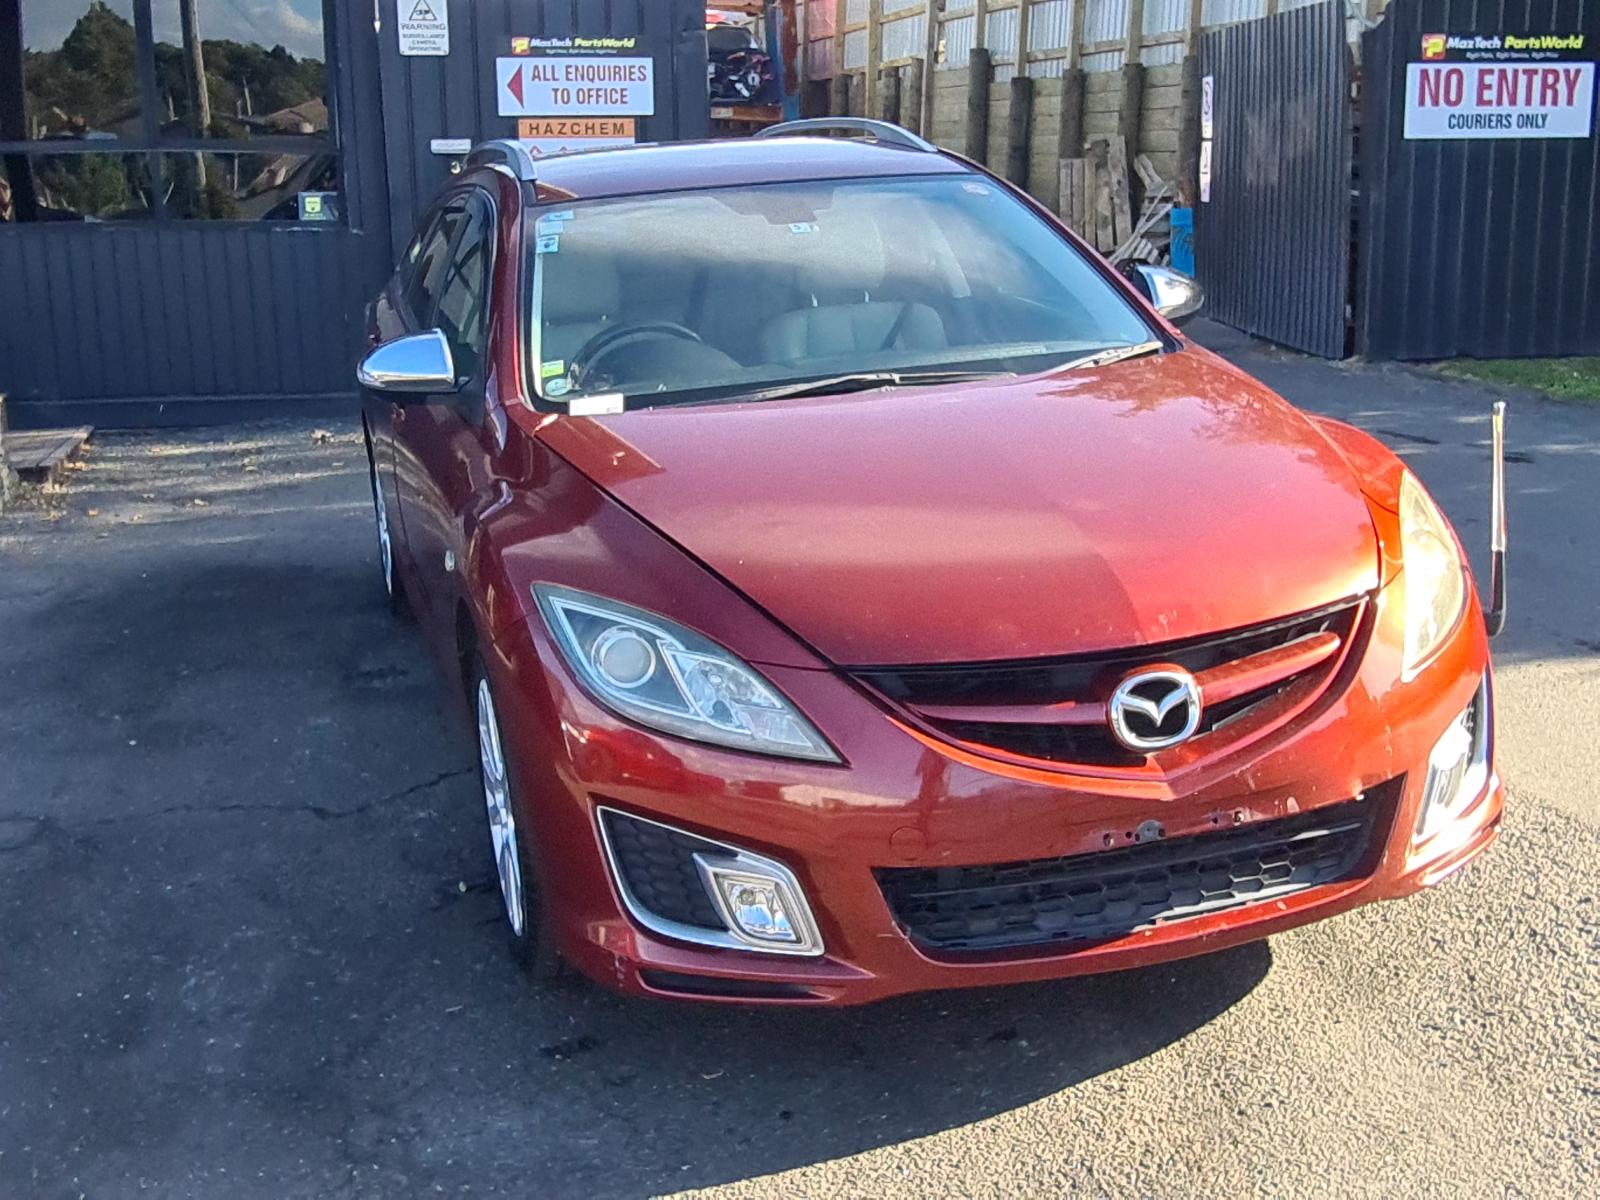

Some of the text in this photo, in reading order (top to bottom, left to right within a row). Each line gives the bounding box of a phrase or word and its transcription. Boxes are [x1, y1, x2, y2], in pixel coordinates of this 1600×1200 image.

[1504, 34, 1585, 50] PartsWorld
[531, 64, 647, 82] ALL ENQUIRIES
[1418, 67, 1582, 107] NO ENTRY
[551, 87, 629, 105] TO OFFICE
[529, 122, 625, 136] HAZCHEM
[1448, 113, 1549, 130] COURIERS ONLY
